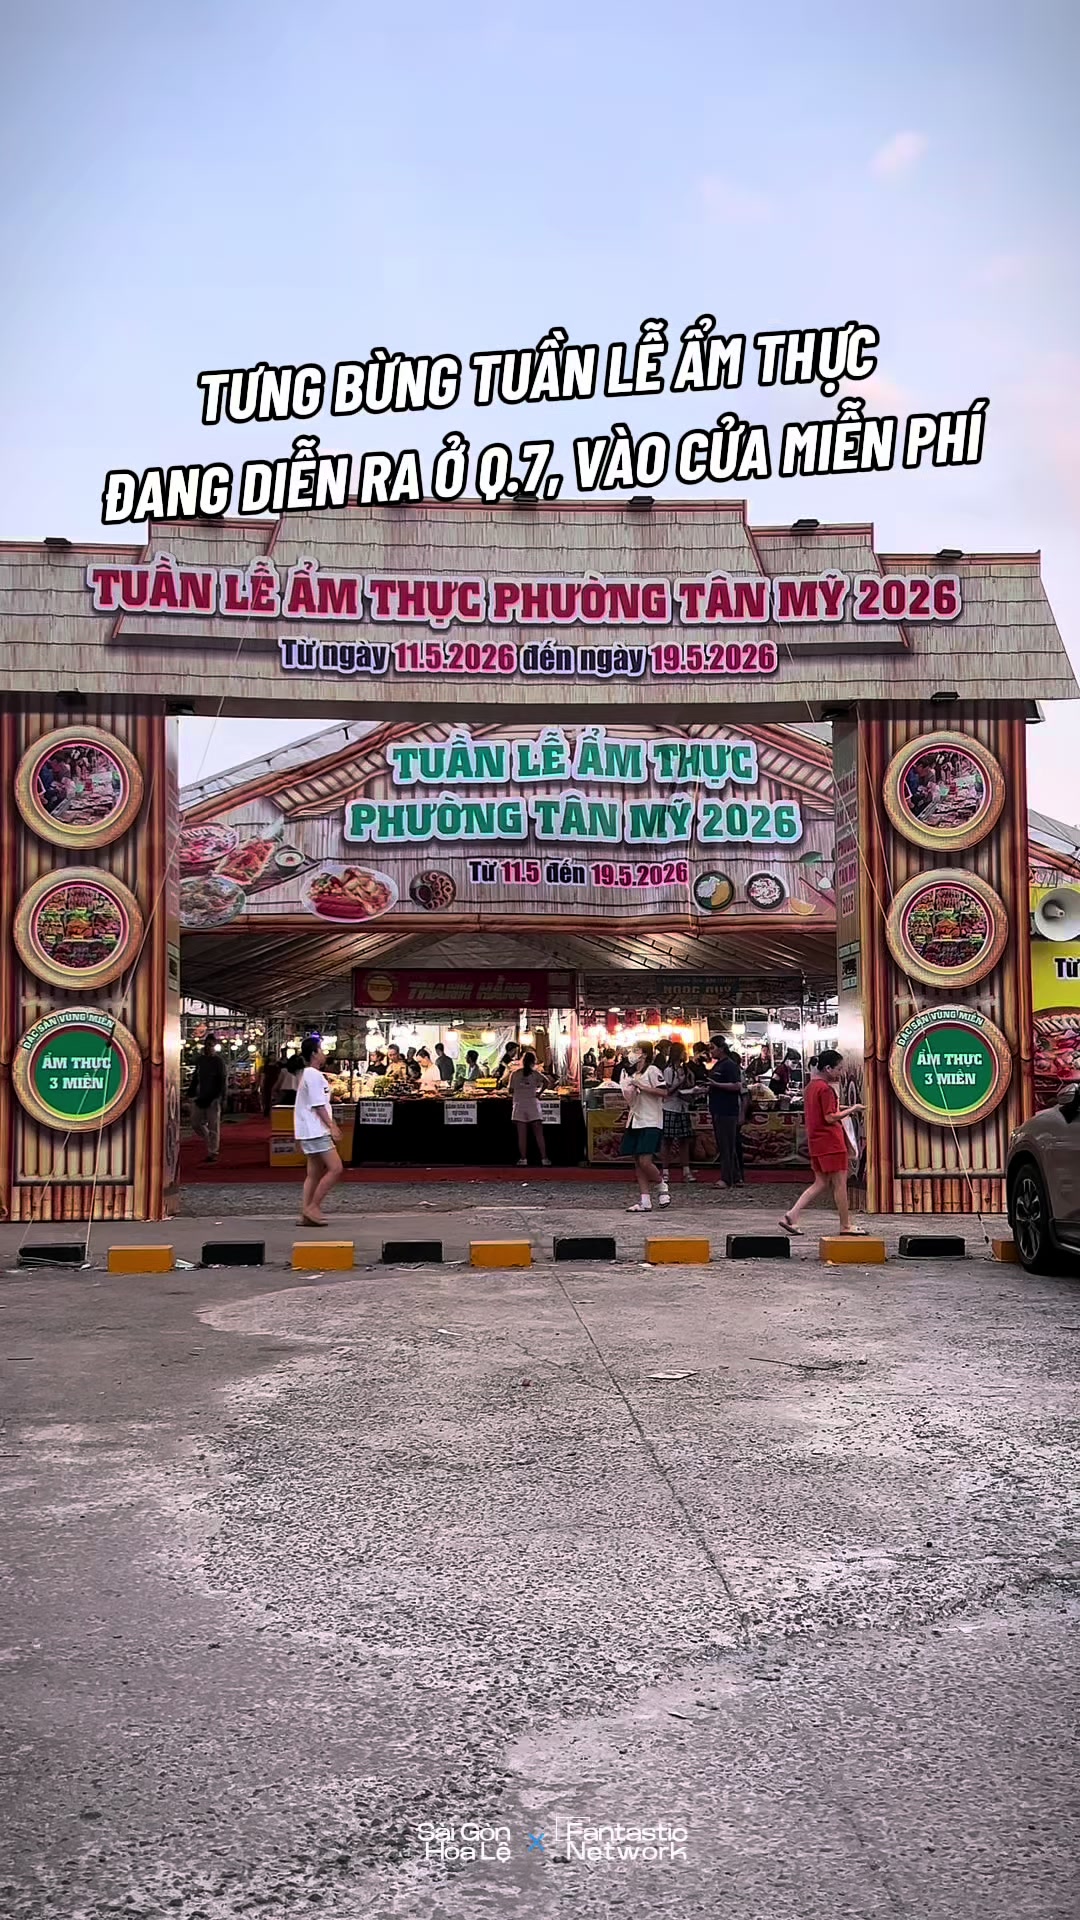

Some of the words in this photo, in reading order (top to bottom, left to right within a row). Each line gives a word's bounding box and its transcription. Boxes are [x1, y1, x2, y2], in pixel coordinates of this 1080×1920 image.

[92, 557, 213, 610] TUẦN
[225, 561, 276, 613] LỄ
[288, 561, 358, 615] ẨM
[370, 579, 481, 623] THỰC
[494, 575, 666, 619] PHƯỜNG
[679, 575, 766, 619] TÂN
[779, 574, 844, 617] MỸ
[858, 579, 957, 615] 2026
[281, 639, 317, 668] Từ
[319, 643, 387, 672] ngày
[394, 644, 515, 671] 11.5.2026
[522, 639, 571, 671] đến
[581, 645, 645, 673] ngày
[651, 644, 775, 671] 19.5.2026
[392, 734, 505, 779] TUẦN
[517, 732, 565, 777] LỄ
[578, 728, 641, 779] ẨM
[653, 743, 753, 783] THỰC
[351, 796, 523, 838] PHƯỜNG
[534, 795, 618, 838] TÂN
[629, 798, 692, 839] MỸ
[702, 803, 797, 838] 2026
[469, 860, 499, 883] Từ
[501, 861, 540, 883] 11.5
[546, 859, 585, 884] đến
[591, 861, 688, 886] 19.5.2026
[944, 1053, 983, 1068] THỰC
[49, 1077, 58, 1090] 3
[62, 1072, 104, 1089] MIỀN
[924, 1073, 933, 1085] 3
[937, 1068, 976, 1085] MIỀN
